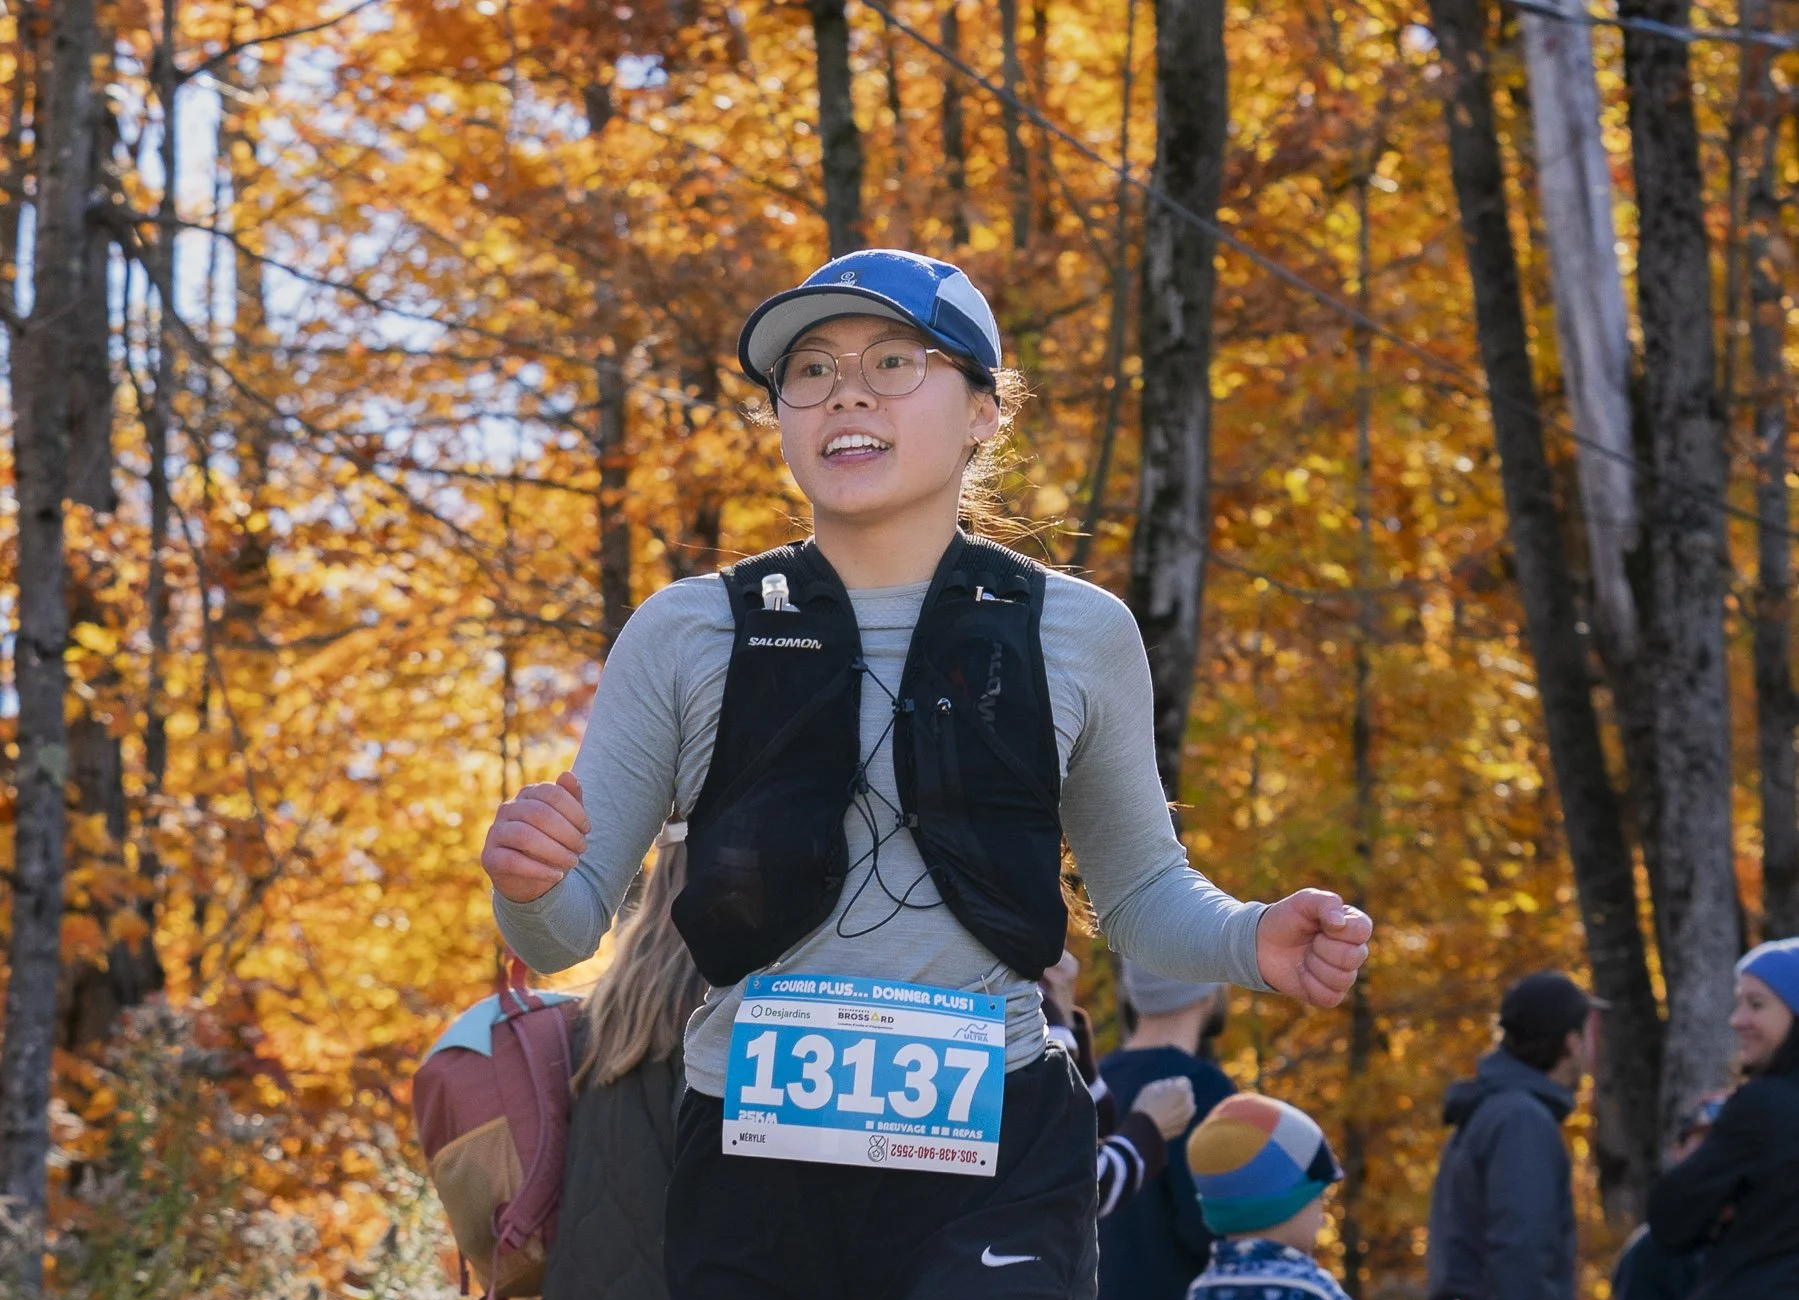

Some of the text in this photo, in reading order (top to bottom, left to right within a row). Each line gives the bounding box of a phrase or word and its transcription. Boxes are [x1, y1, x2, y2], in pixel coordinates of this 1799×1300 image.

[748, 636, 822, 649] SALOMON
[772, 980, 975, 1011] COURIR PLUS... DONNER PLUS!
[764, 1007, 811, 1019] Desjardins
[963, 1033, 989, 1043] ULTRA
[740, 1030, 990, 1122] 13137
[738, 1109, 778, 1124] 25KM
[877, 1121, 927, 1134] BREUVAGE
[952, 1127, 984, 1139] REPAS
[739, 1132, 766, 1143] MÉRYLIE
[891, 1143, 978, 1163] SOS:438-940-2552
